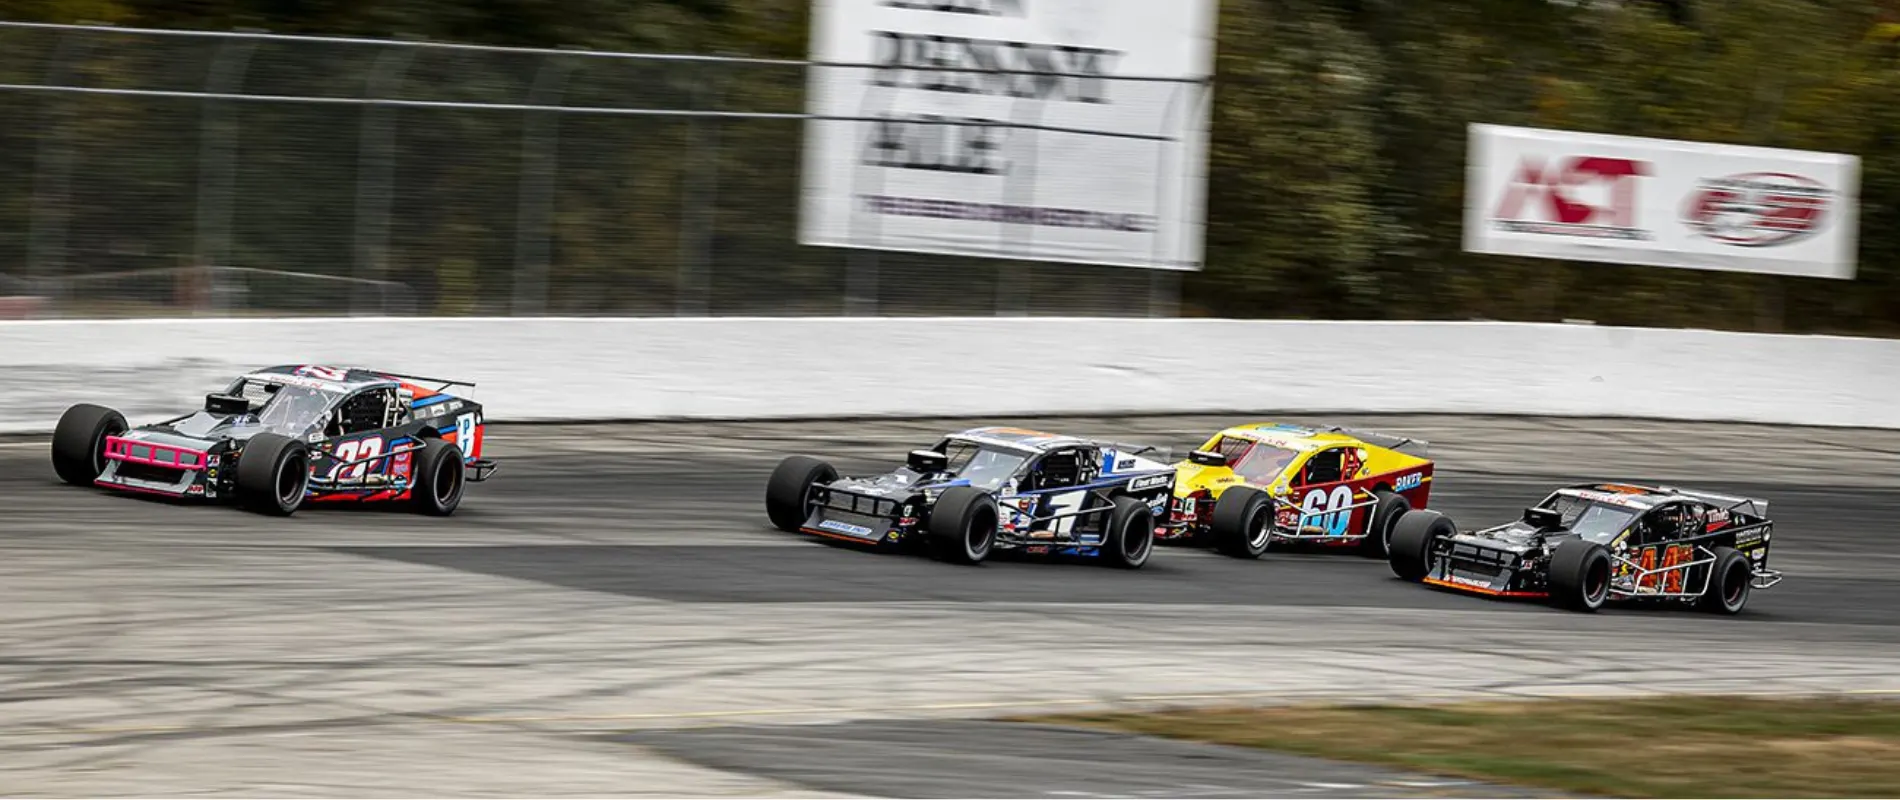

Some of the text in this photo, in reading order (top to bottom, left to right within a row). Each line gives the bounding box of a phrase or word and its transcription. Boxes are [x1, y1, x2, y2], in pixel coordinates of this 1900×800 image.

[1492, 153, 1655, 230] ACT
[327, 434, 384, 480] 22
[1395, 472, 1422, 492] BAKER
[1299, 485, 1353, 536] 60
[1633, 543, 1683, 593] 44
